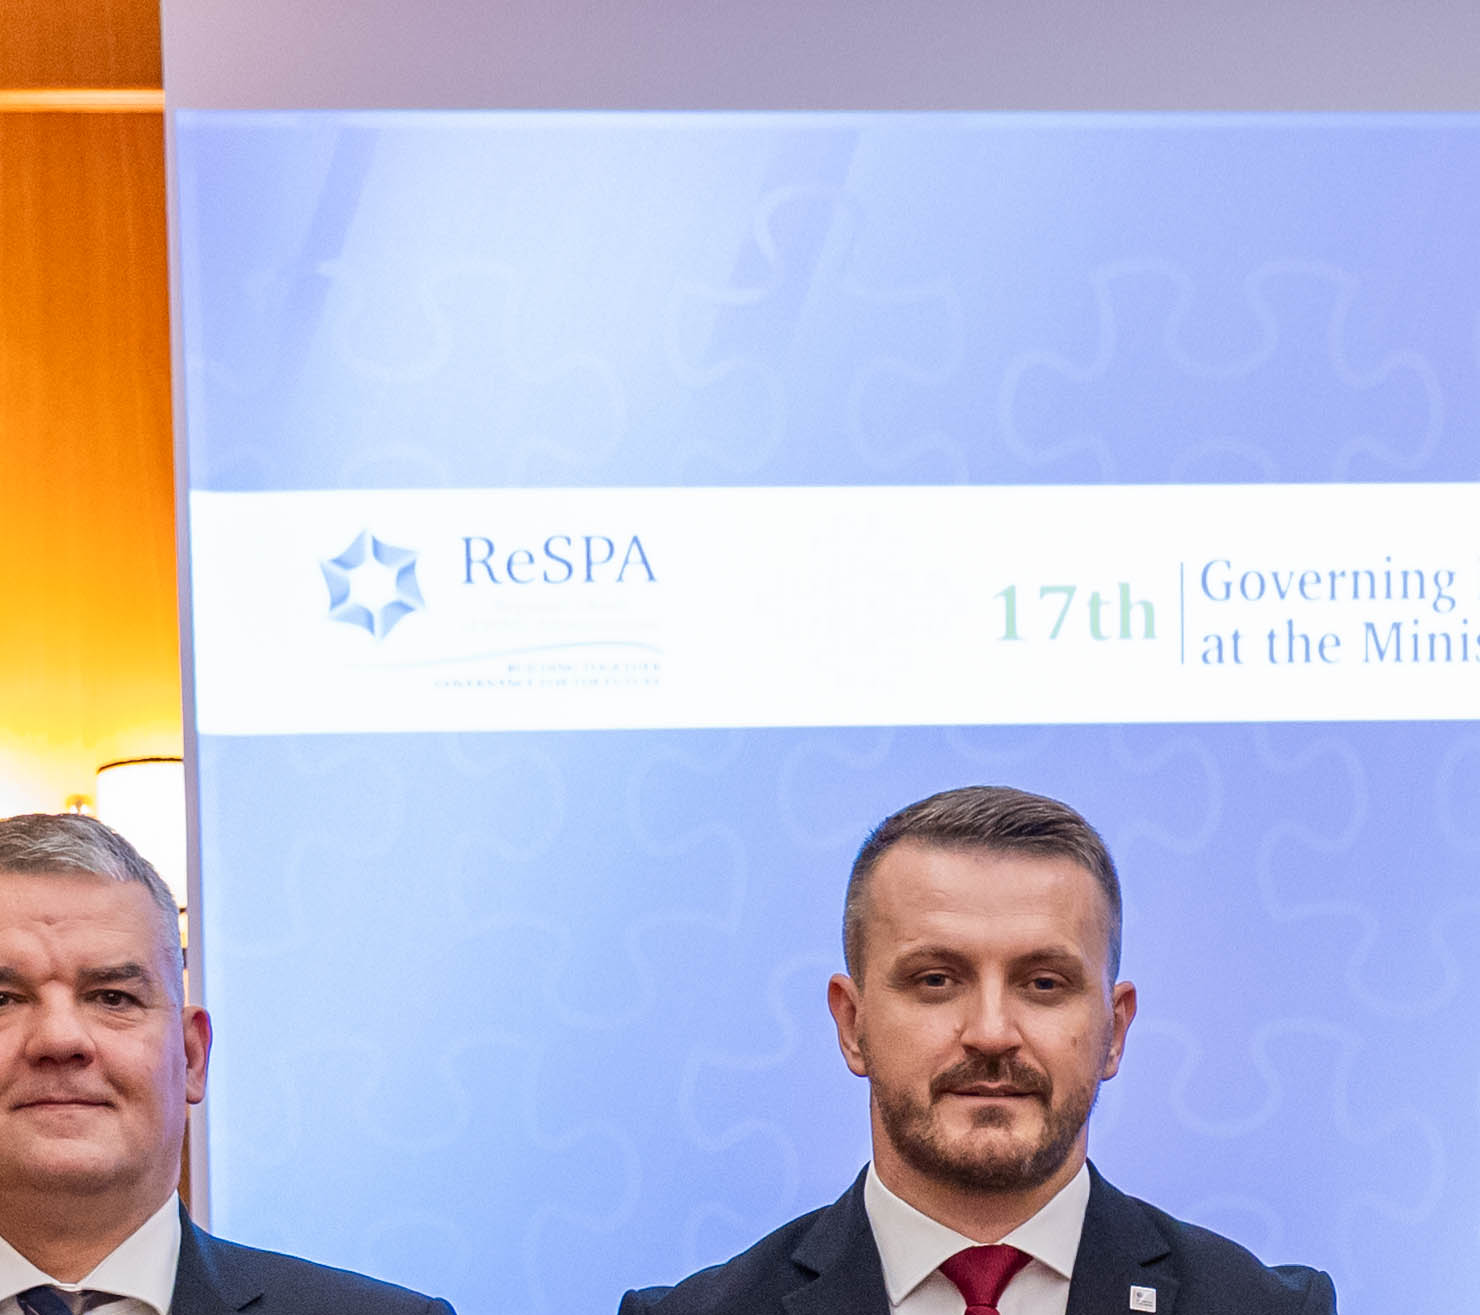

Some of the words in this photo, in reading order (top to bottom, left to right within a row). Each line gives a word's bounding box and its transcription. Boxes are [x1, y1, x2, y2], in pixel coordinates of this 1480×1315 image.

[461, 534, 658, 585] ReSPA
[1200, 555, 1457, 614] Governing
[995, 582, 1158, 641] 17th
[1200, 628, 1244, 665] at
[1266, 618, 1342, 665] the
